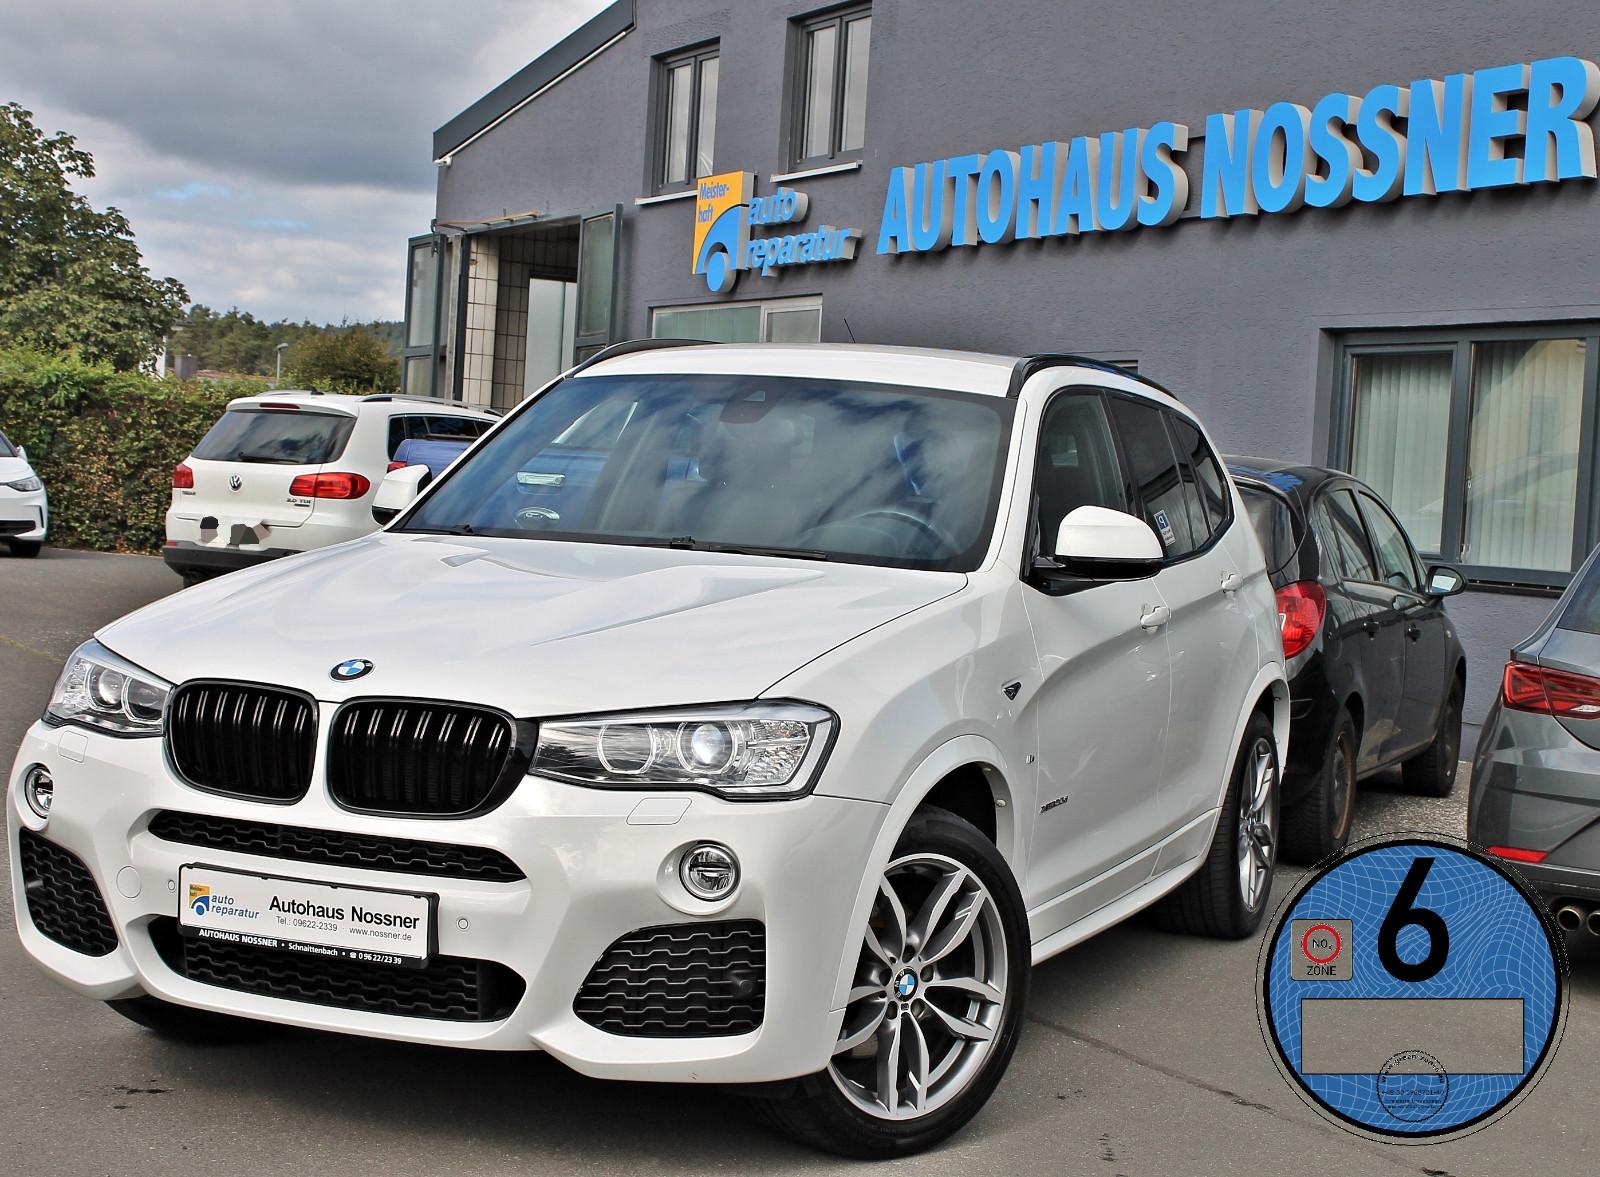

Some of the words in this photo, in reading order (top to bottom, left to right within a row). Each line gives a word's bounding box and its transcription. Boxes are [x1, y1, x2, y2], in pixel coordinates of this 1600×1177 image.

[876, 121, 1188, 255] AUTOHAUS
[1200, 56, 1599, 219] NOSSNER
[699, 181, 729, 200] Meister-
[698, 203, 713, 223] haft
[748, 187, 806, 225] auto
[747, 225, 860, 277] reparatur
[211, 895, 235, 905] auto
[211, 905, 260, 919] reparatur
[269, 895, 345, 920] Autohaus
[351, 906, 420, 929] Nossner
[276, 915, 291, 926] Tel.:
[293, 917, 338, 932] 09622-2339
[349, 927, 412, 941] www.nossner.de
[198, 928, 240, 942] AUTOHAUS
[241, 935, 278, 948] NOSSNER
[288, 942, 338, 956] Schnaittenbach
